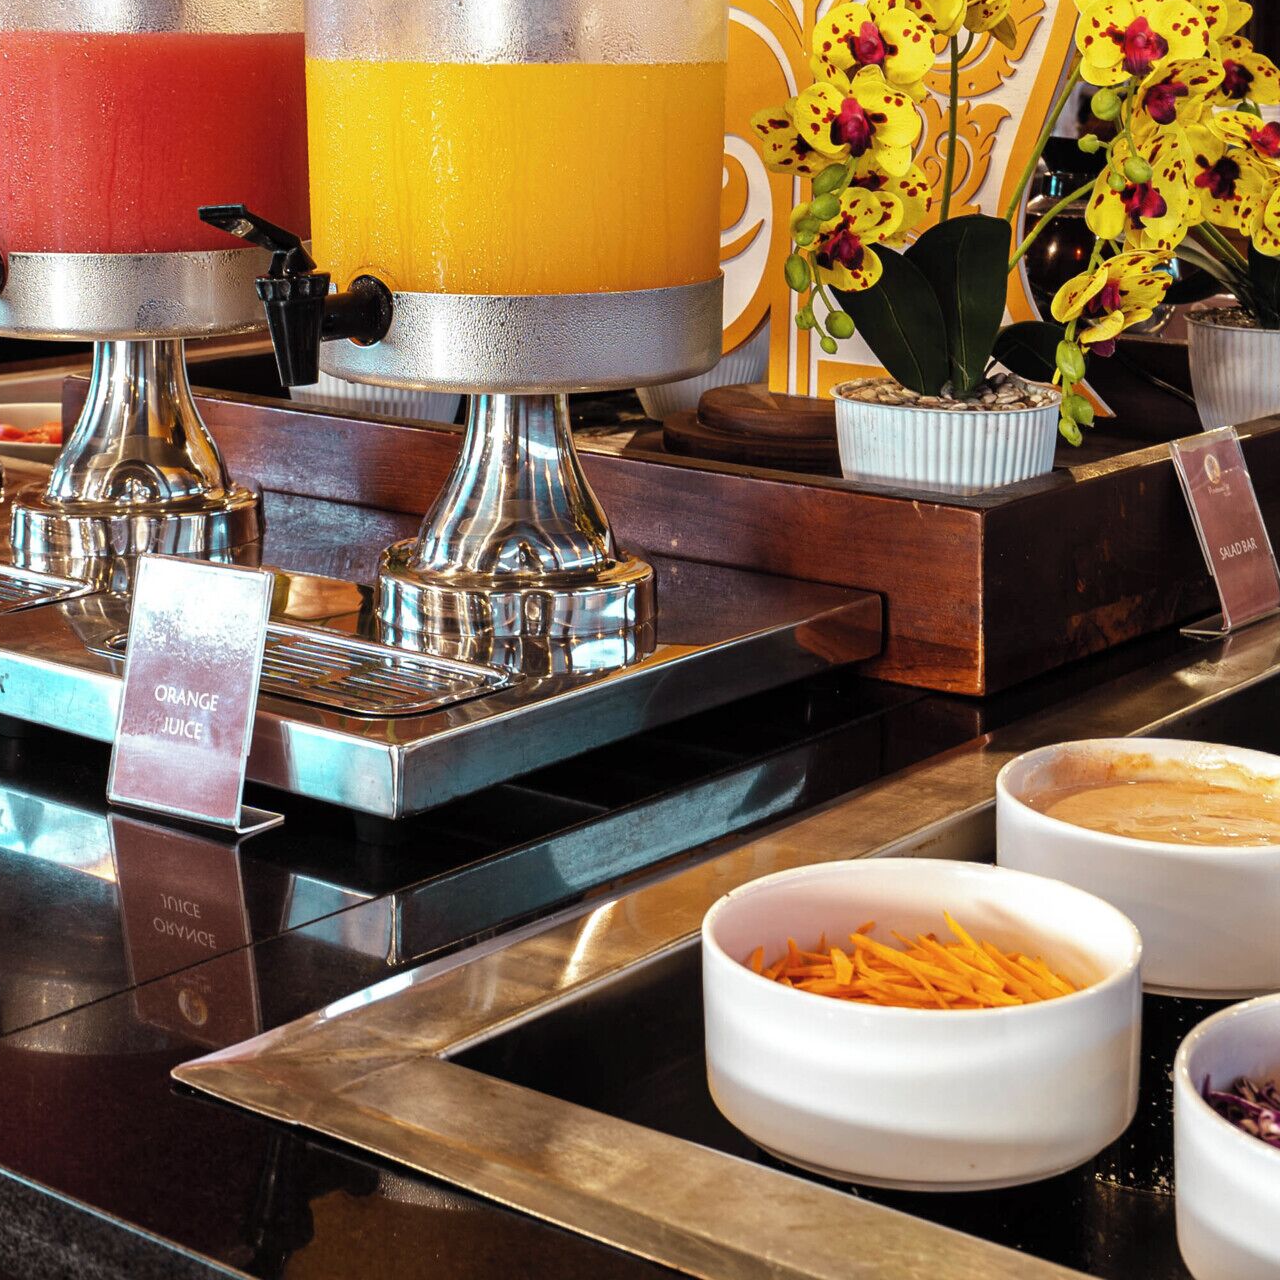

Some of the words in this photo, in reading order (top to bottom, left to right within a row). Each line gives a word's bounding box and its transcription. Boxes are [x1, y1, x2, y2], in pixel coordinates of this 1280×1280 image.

[1219, 542, 1242, 561] SALAD
[1241, 537, 1258, 553] BAR
[154, 684, 220, 712] ORANGE
[161, 716, 204, 741] JUICE
